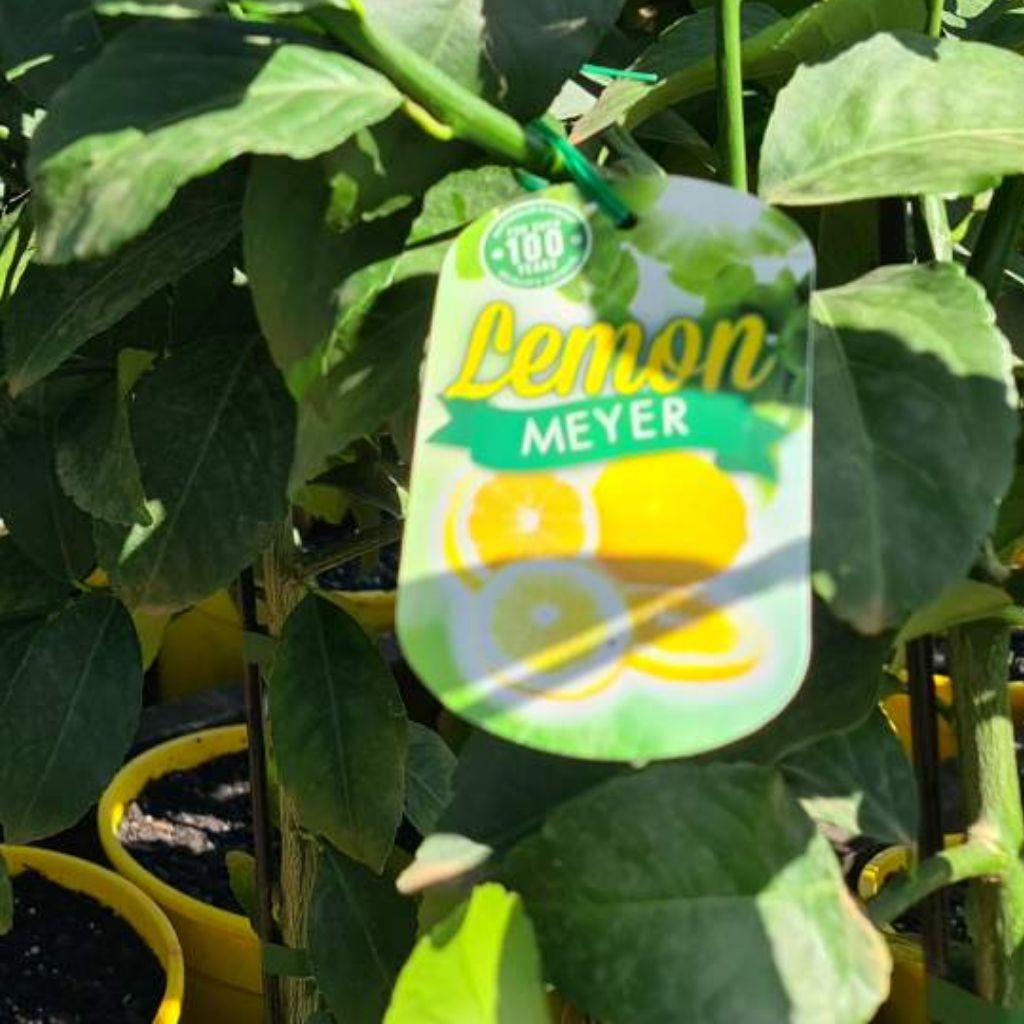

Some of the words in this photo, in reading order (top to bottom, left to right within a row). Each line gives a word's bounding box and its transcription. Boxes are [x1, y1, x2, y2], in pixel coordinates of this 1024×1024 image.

[506, 227, 564, 266] 100
[444, 299, 775, 398] Lemon
[520, 396, 689, 457] MEYER
